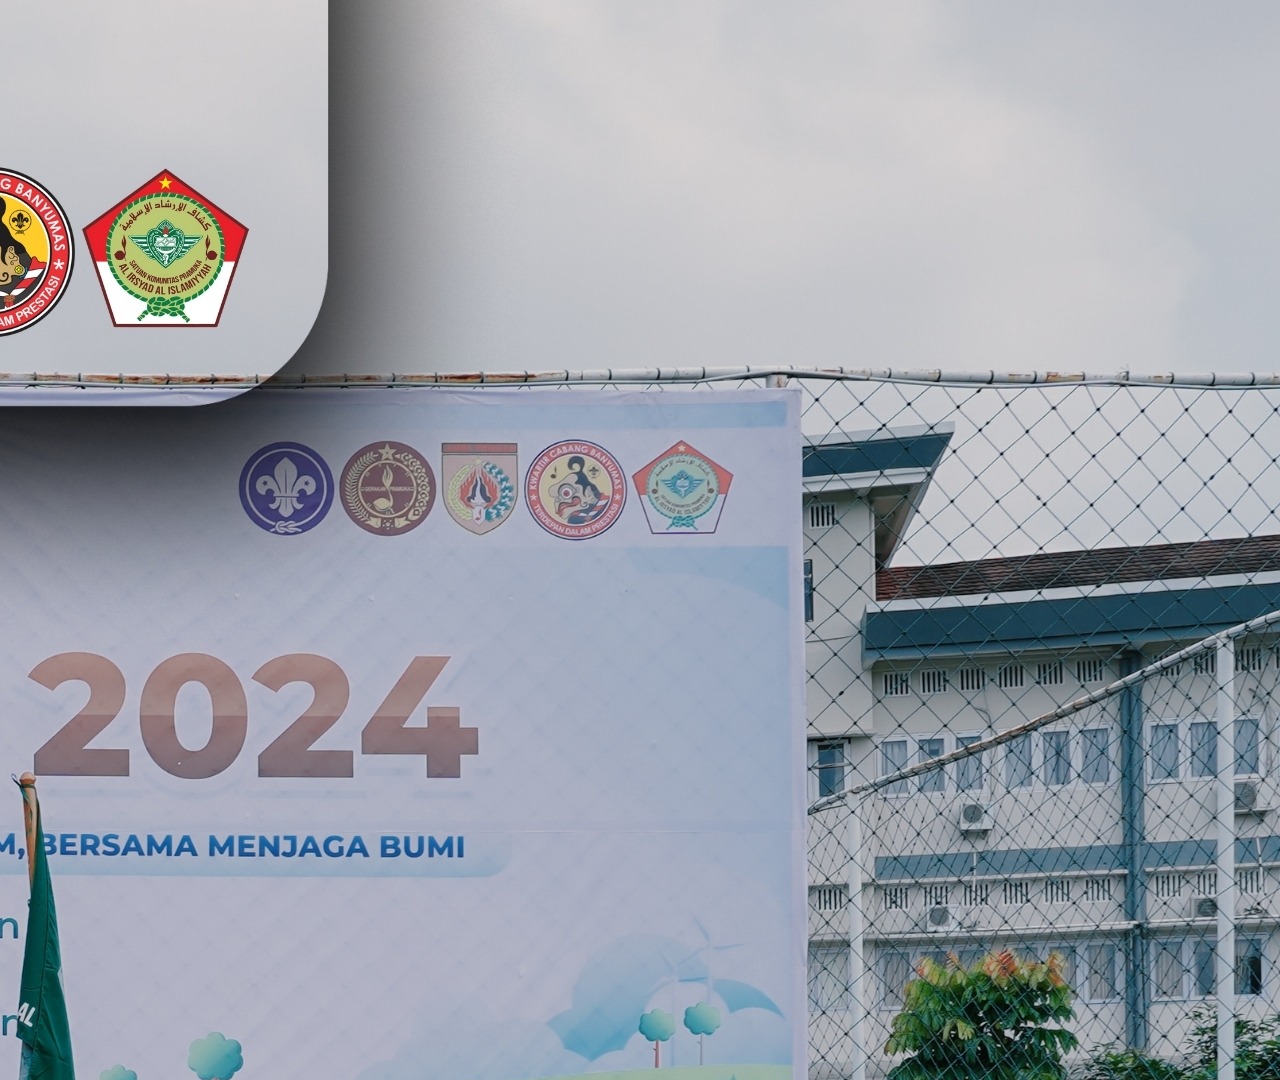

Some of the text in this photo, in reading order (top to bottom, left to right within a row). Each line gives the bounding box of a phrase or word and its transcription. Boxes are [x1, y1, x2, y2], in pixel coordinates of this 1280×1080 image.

[549, 445, 589, 459] CABANG
[590, 448, 623, 491] BANYUMAS
[533, 504, 619, 536] TERDEPAN DALAM PRESTASI
[27, 650, 480, 779] 2024
[43, 833, 199, 857] BERSAMA
[209, 835, 370, 858] MENJAGA
[380, 835, 465, 858] BUMI
